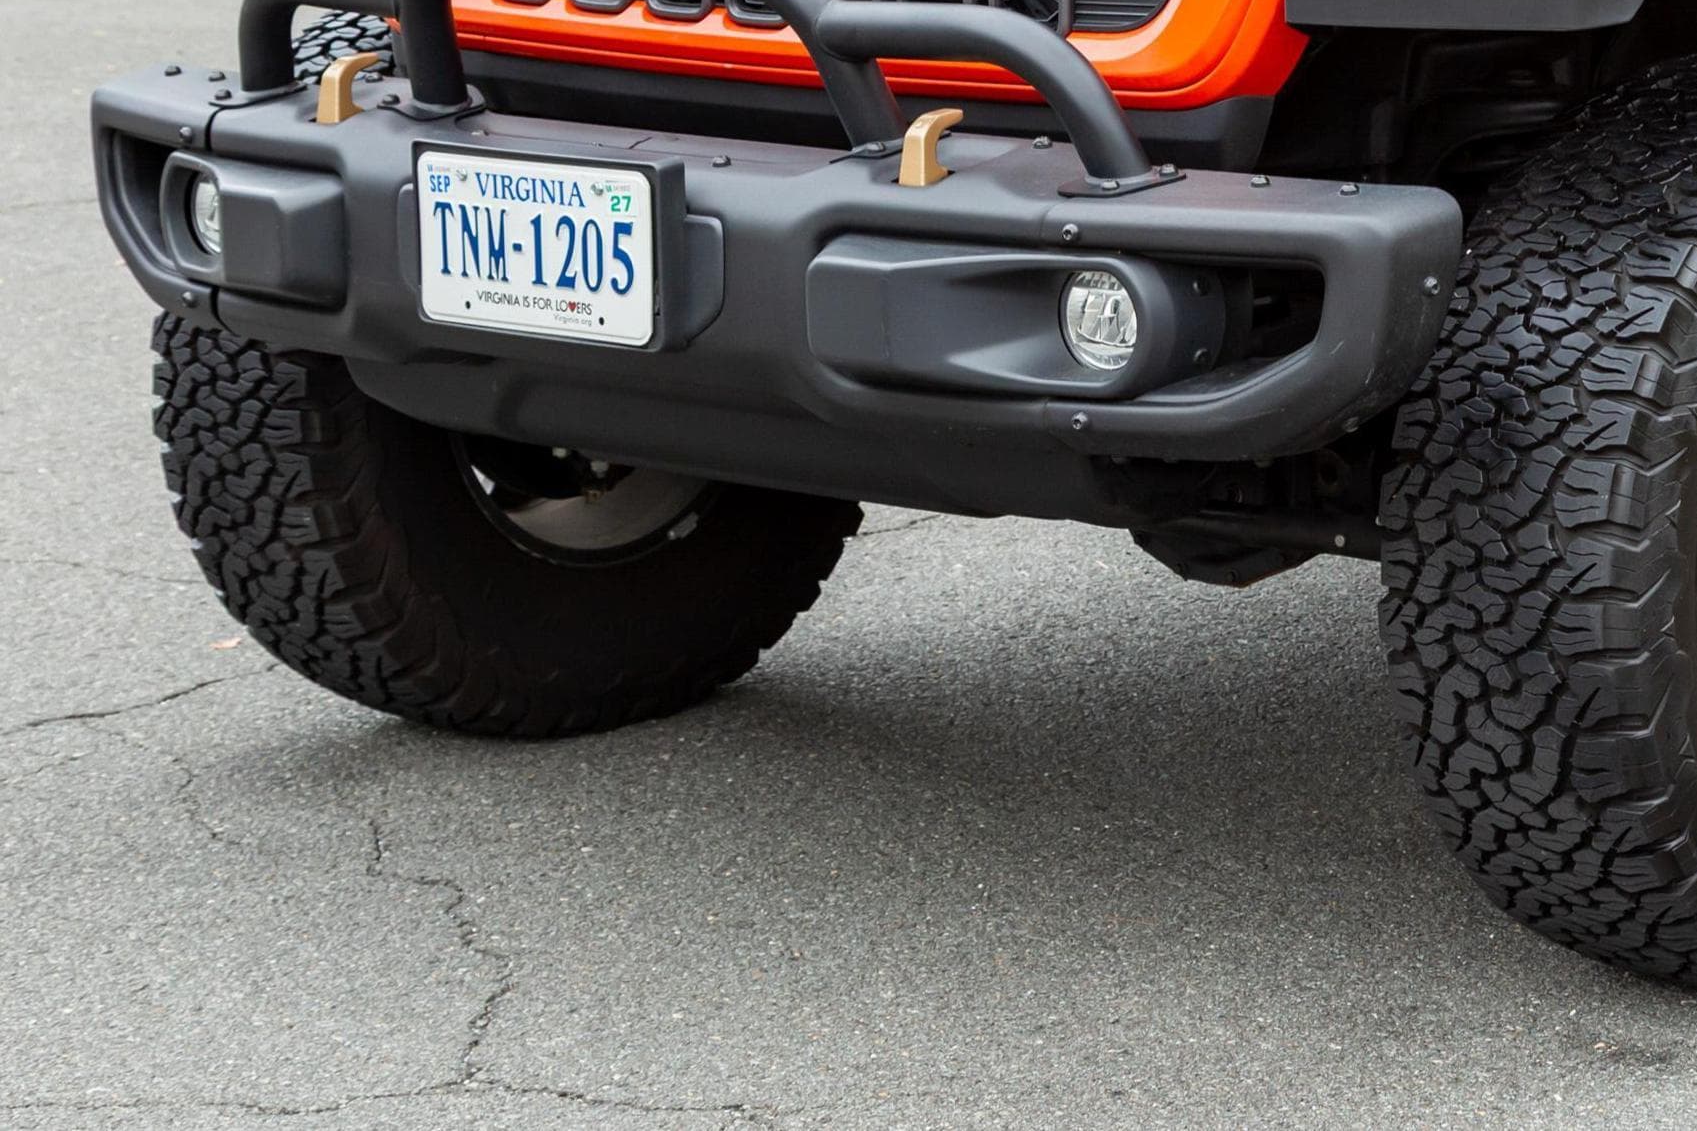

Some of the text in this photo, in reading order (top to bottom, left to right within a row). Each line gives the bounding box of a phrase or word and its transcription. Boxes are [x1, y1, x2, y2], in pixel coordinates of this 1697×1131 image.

[429, 174, 451, 194] SEP
[475, 172, 586, 208] VIRGINIA
[610, 195, 632, 213] 27
[433, 201, 635, 296] TNM-1205
[476, 289, 520, 307] VIRGINIA
[522, 294, 531, 309] IS
[532, 296, 553, 310] FOR
